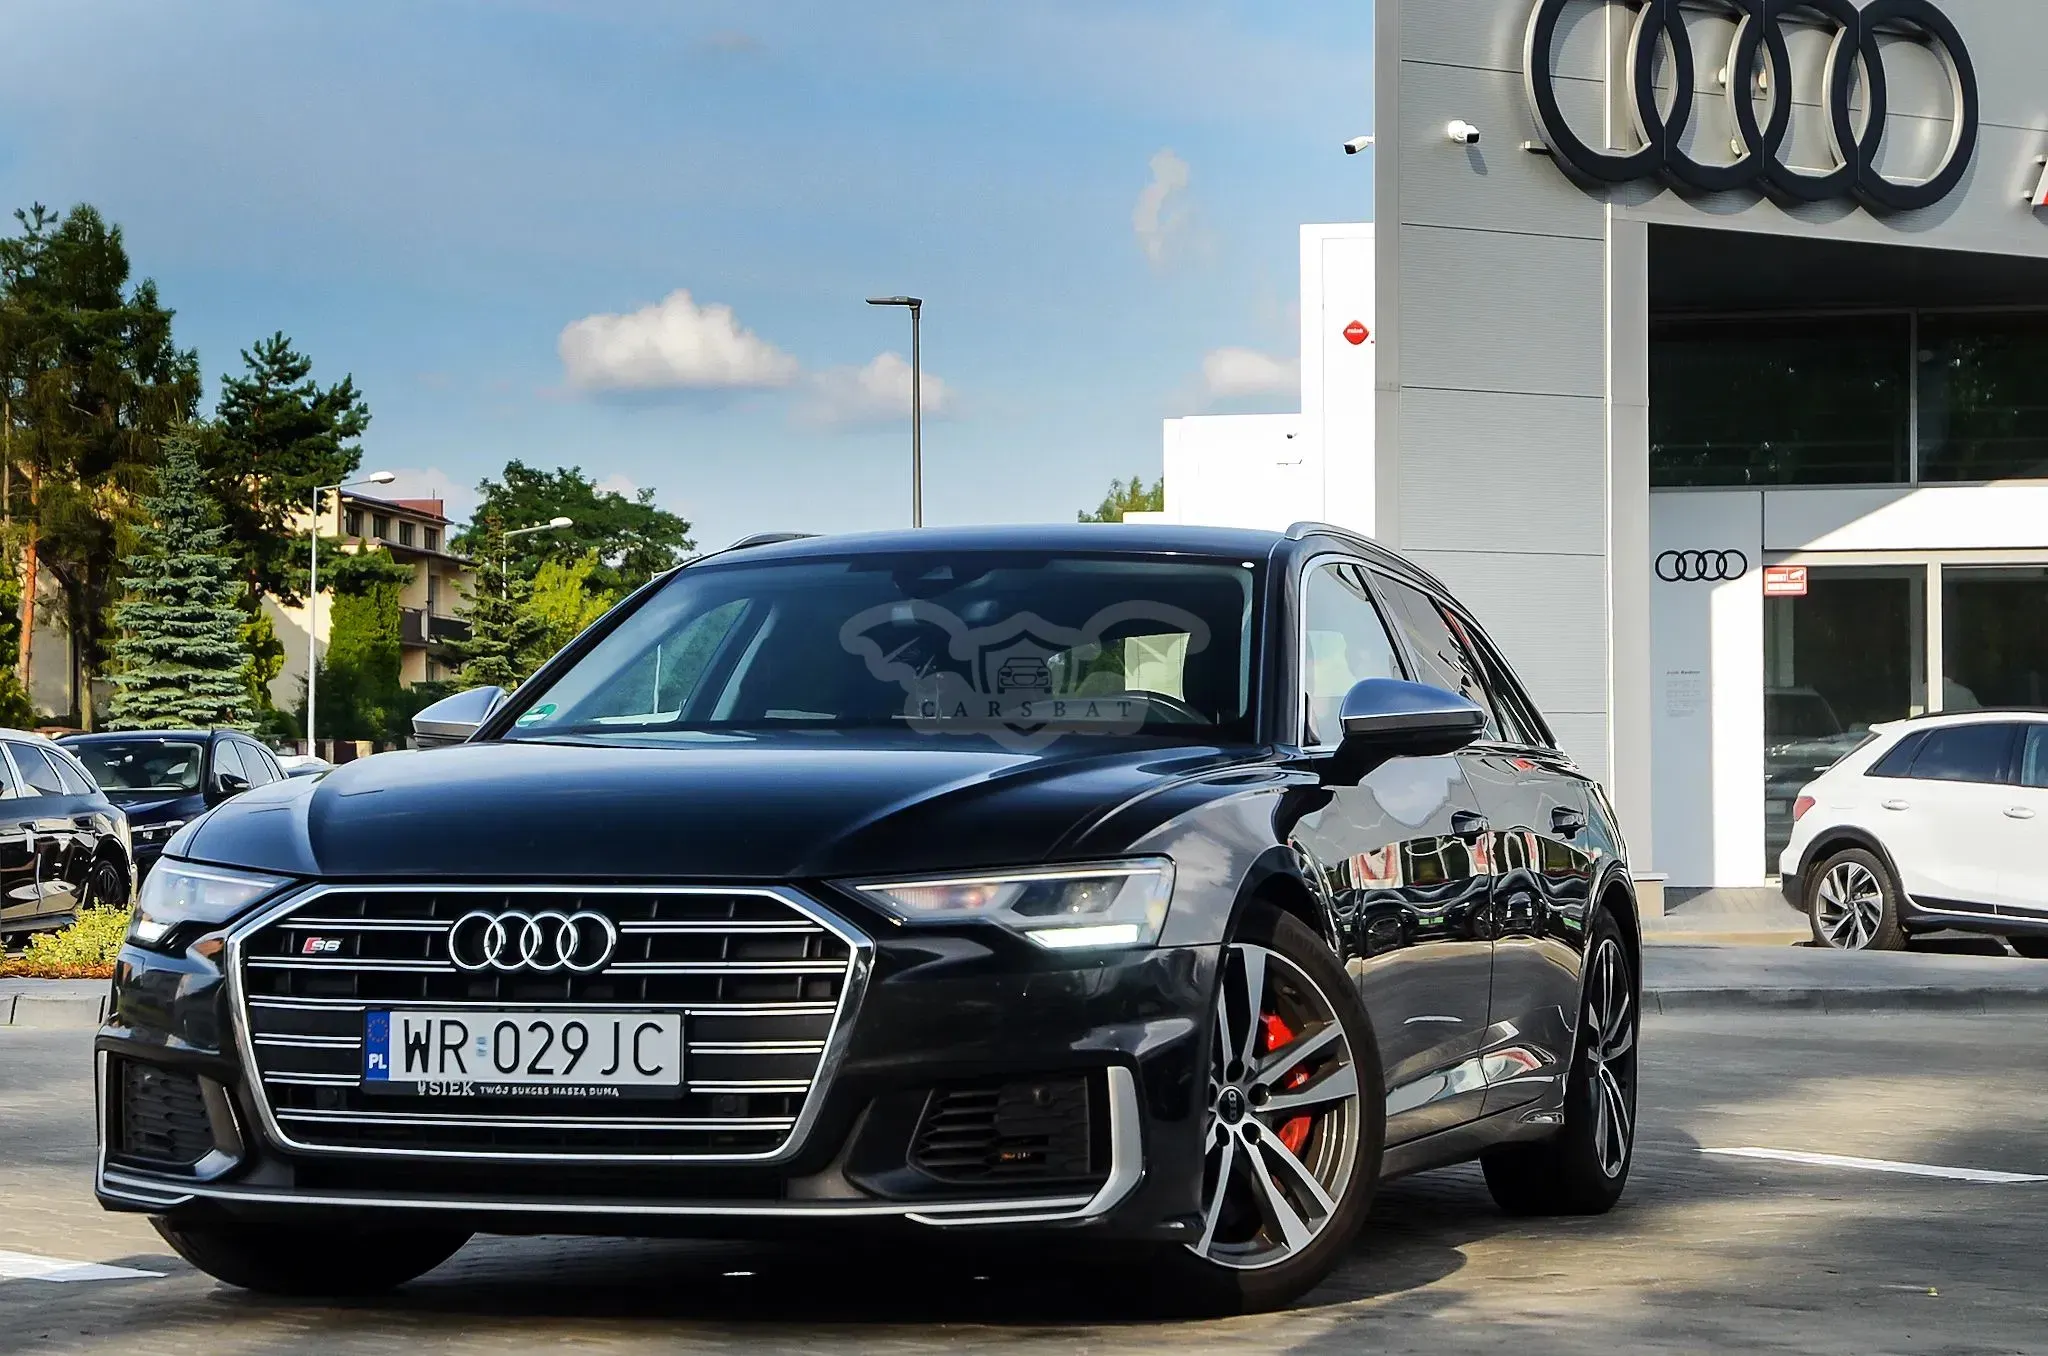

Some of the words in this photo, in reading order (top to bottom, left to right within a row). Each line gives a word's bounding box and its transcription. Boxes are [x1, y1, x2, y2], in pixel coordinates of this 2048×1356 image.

[305, 938, 342, 952] S6
[404, 1019, 468, 1073] WR
[494, 1020, 589, 1075] 029
[600, 1021, 664, 1076] JC
[368, 1053, 387, 1069] PL
